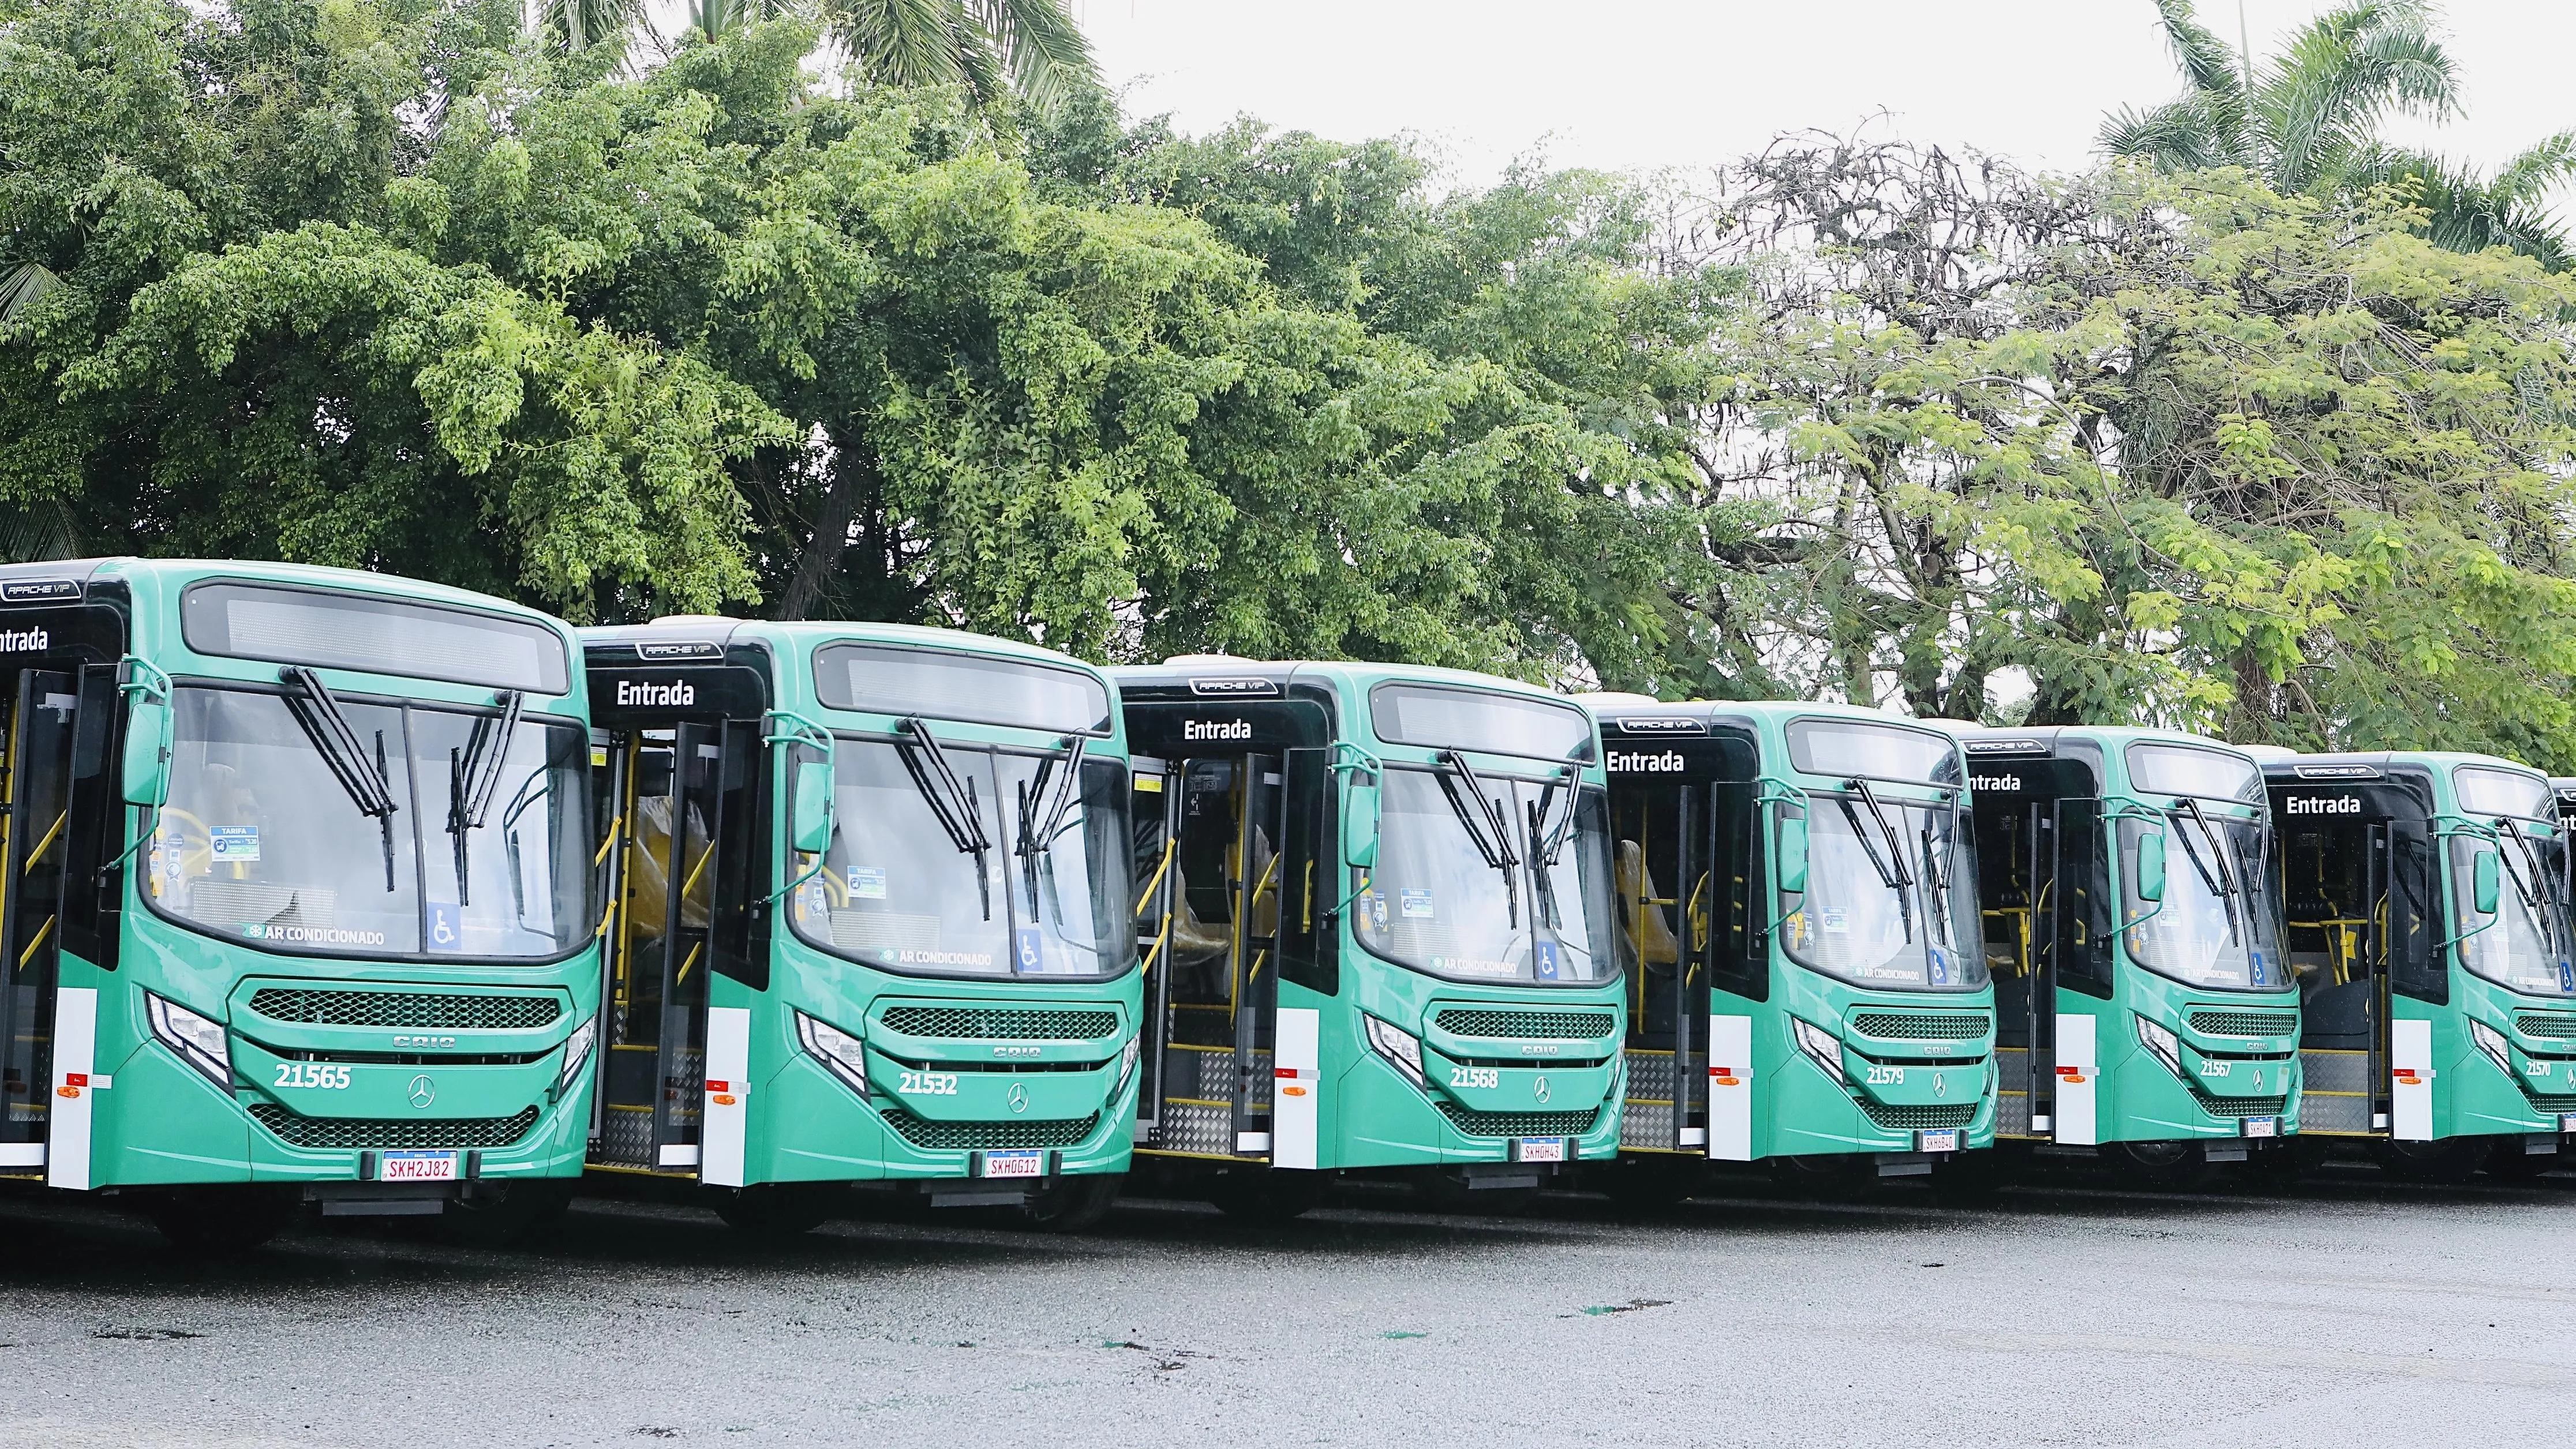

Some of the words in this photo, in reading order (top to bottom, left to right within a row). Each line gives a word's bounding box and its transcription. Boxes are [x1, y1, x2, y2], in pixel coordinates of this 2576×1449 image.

[8, 585, 53, 595] APACHE
[53, 584, 70, 593] VIP
[0, 626, 48, 652] trada
[646, 645, 692, 654] APACHE
[693, 645, 711, 653] VIP
[617, 679, 694, 706] Entrada
[1184, 718, 1251, 740] Entrada
[1607, 750, 1684, 772] Entrada
[1968, 773, 2021, 791] ntrada
[2287, 795, 2361, 814] Entrada
[264, 926, 284, 940] AR
[286, 927, 385, 946] CONDICIONADO
[899, 950, 915, 963] AR
[915, 950, 992, 966] CONDICIONADO
[1444, 958, 1457, 969] AR
[1457, 958, 1516, 974] CONDICIONADO
[1864, 968, 1874, 978] AR
[1874, 968, 1920, 981] CONDICIONADO
[393, 1036, 455, 1048] CAIO
[1522, 1045, 1558, 1055] CAIO
[1923, 1046, 1951, 1055] CAIO
[993, 1047, 1041, 1057] CAIO
[274, 1063, 352, 1089] 21565
[1866, 1066, 1904, 1085] 21579
[2200, 1060, 2231, 1077] 21567
[2525, 1061, 2551, 1077] 21570
[898, 1072, 958, 1095] 21532
[1450, 1068, 1499, 1089] 21568
[1525, 1145, 1559, 1159] SKH0H43
[390, 1160, 449, 1177] SKH2J82
[991, 1159, 1036, 1174] SKH0G12
